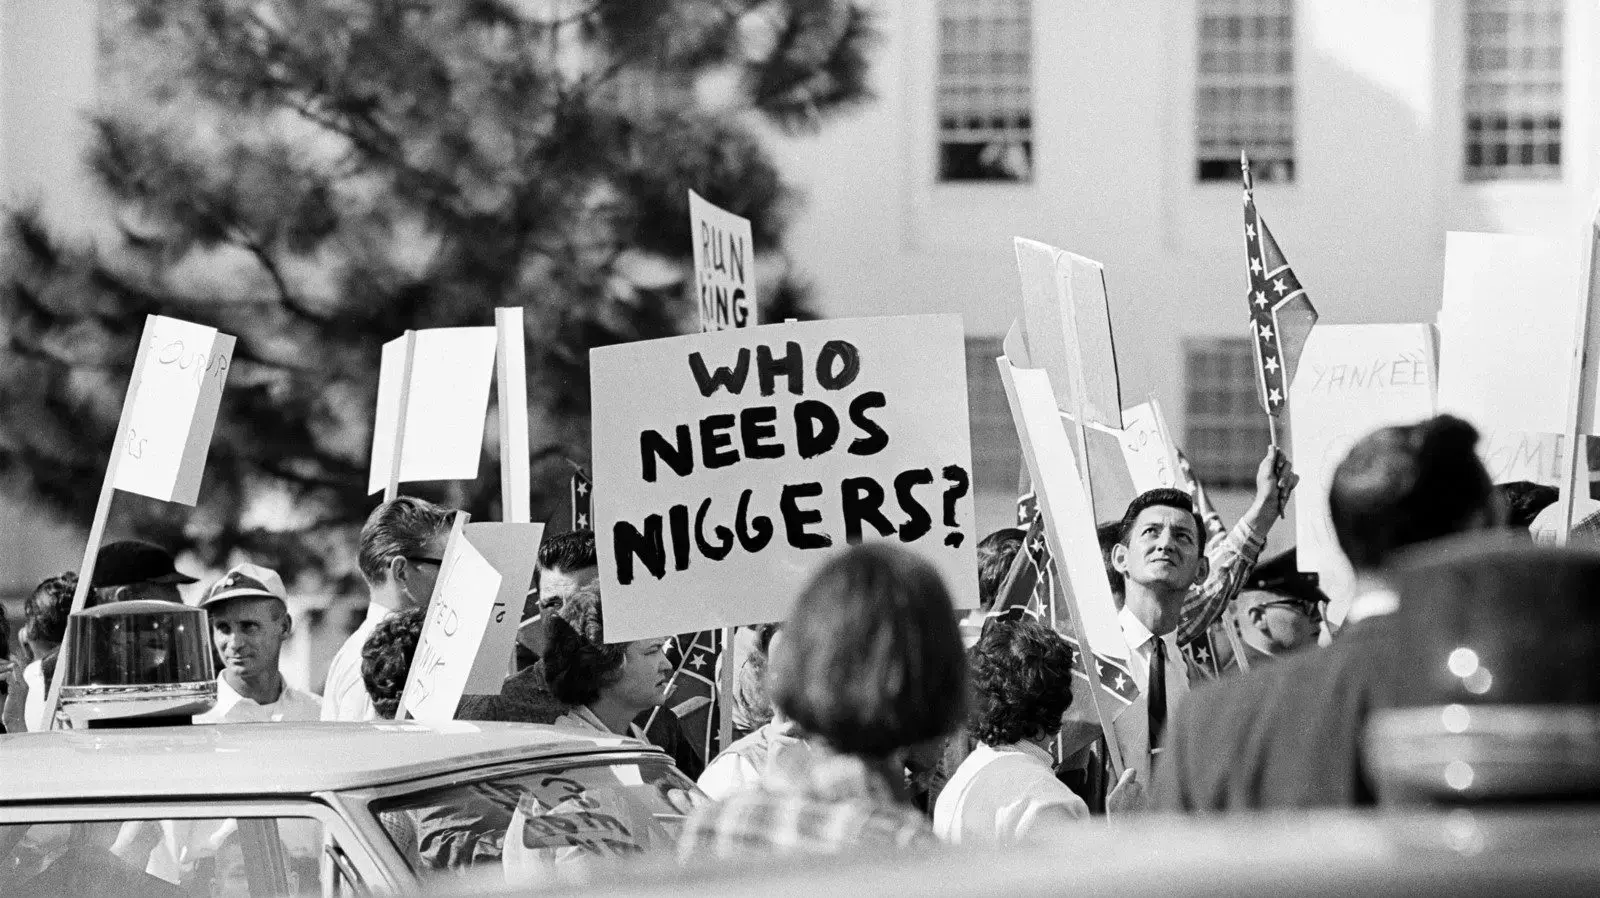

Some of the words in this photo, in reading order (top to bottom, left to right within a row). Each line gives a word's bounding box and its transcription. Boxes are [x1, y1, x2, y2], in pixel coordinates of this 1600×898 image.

[701, 219, 744, 284] RUN
[701, 284, 748, 328] KING
[688, 340, 860, 397] WHO
[1312, 353, 1425, 391] YANKEE
[640, 391, 889, 482] NEEDS
[613, 464, 969, 585] NIGGERS?
